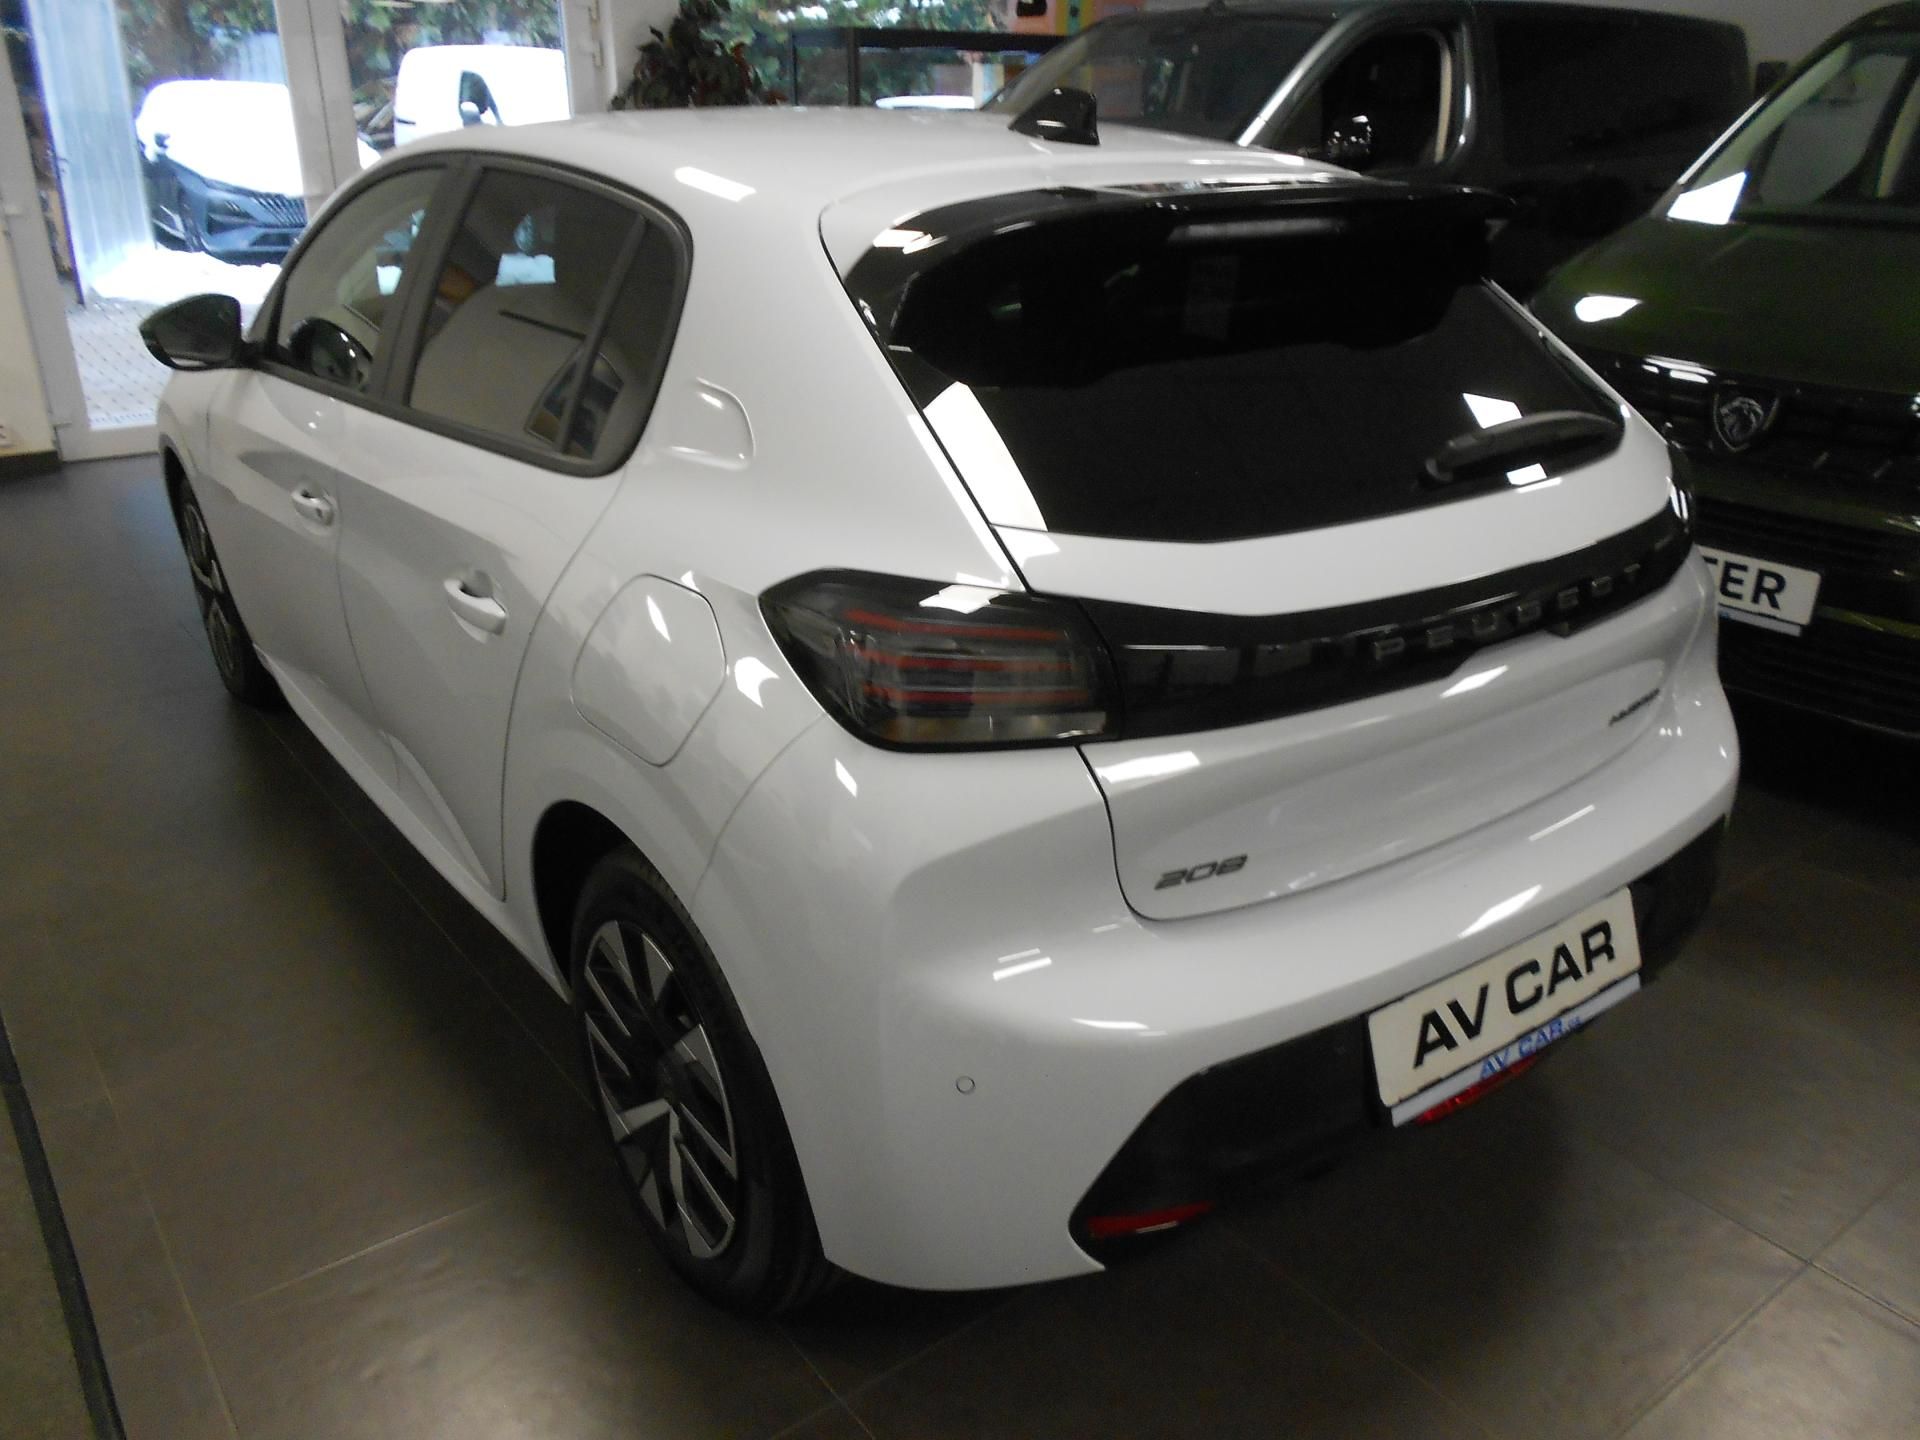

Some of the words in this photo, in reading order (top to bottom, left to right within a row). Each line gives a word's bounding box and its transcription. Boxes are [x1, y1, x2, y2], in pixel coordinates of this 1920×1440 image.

[1702, 554, 1786, 610] ER
[1373, 563, 1641, 661] PEUGEOT
[1153, 853, 1248, 891] 208
[1412, 982, 1489, 1069] AV
[1505, 920, 1615, 1015] CAR
[1479, 1046, 1510, 1080] AV
